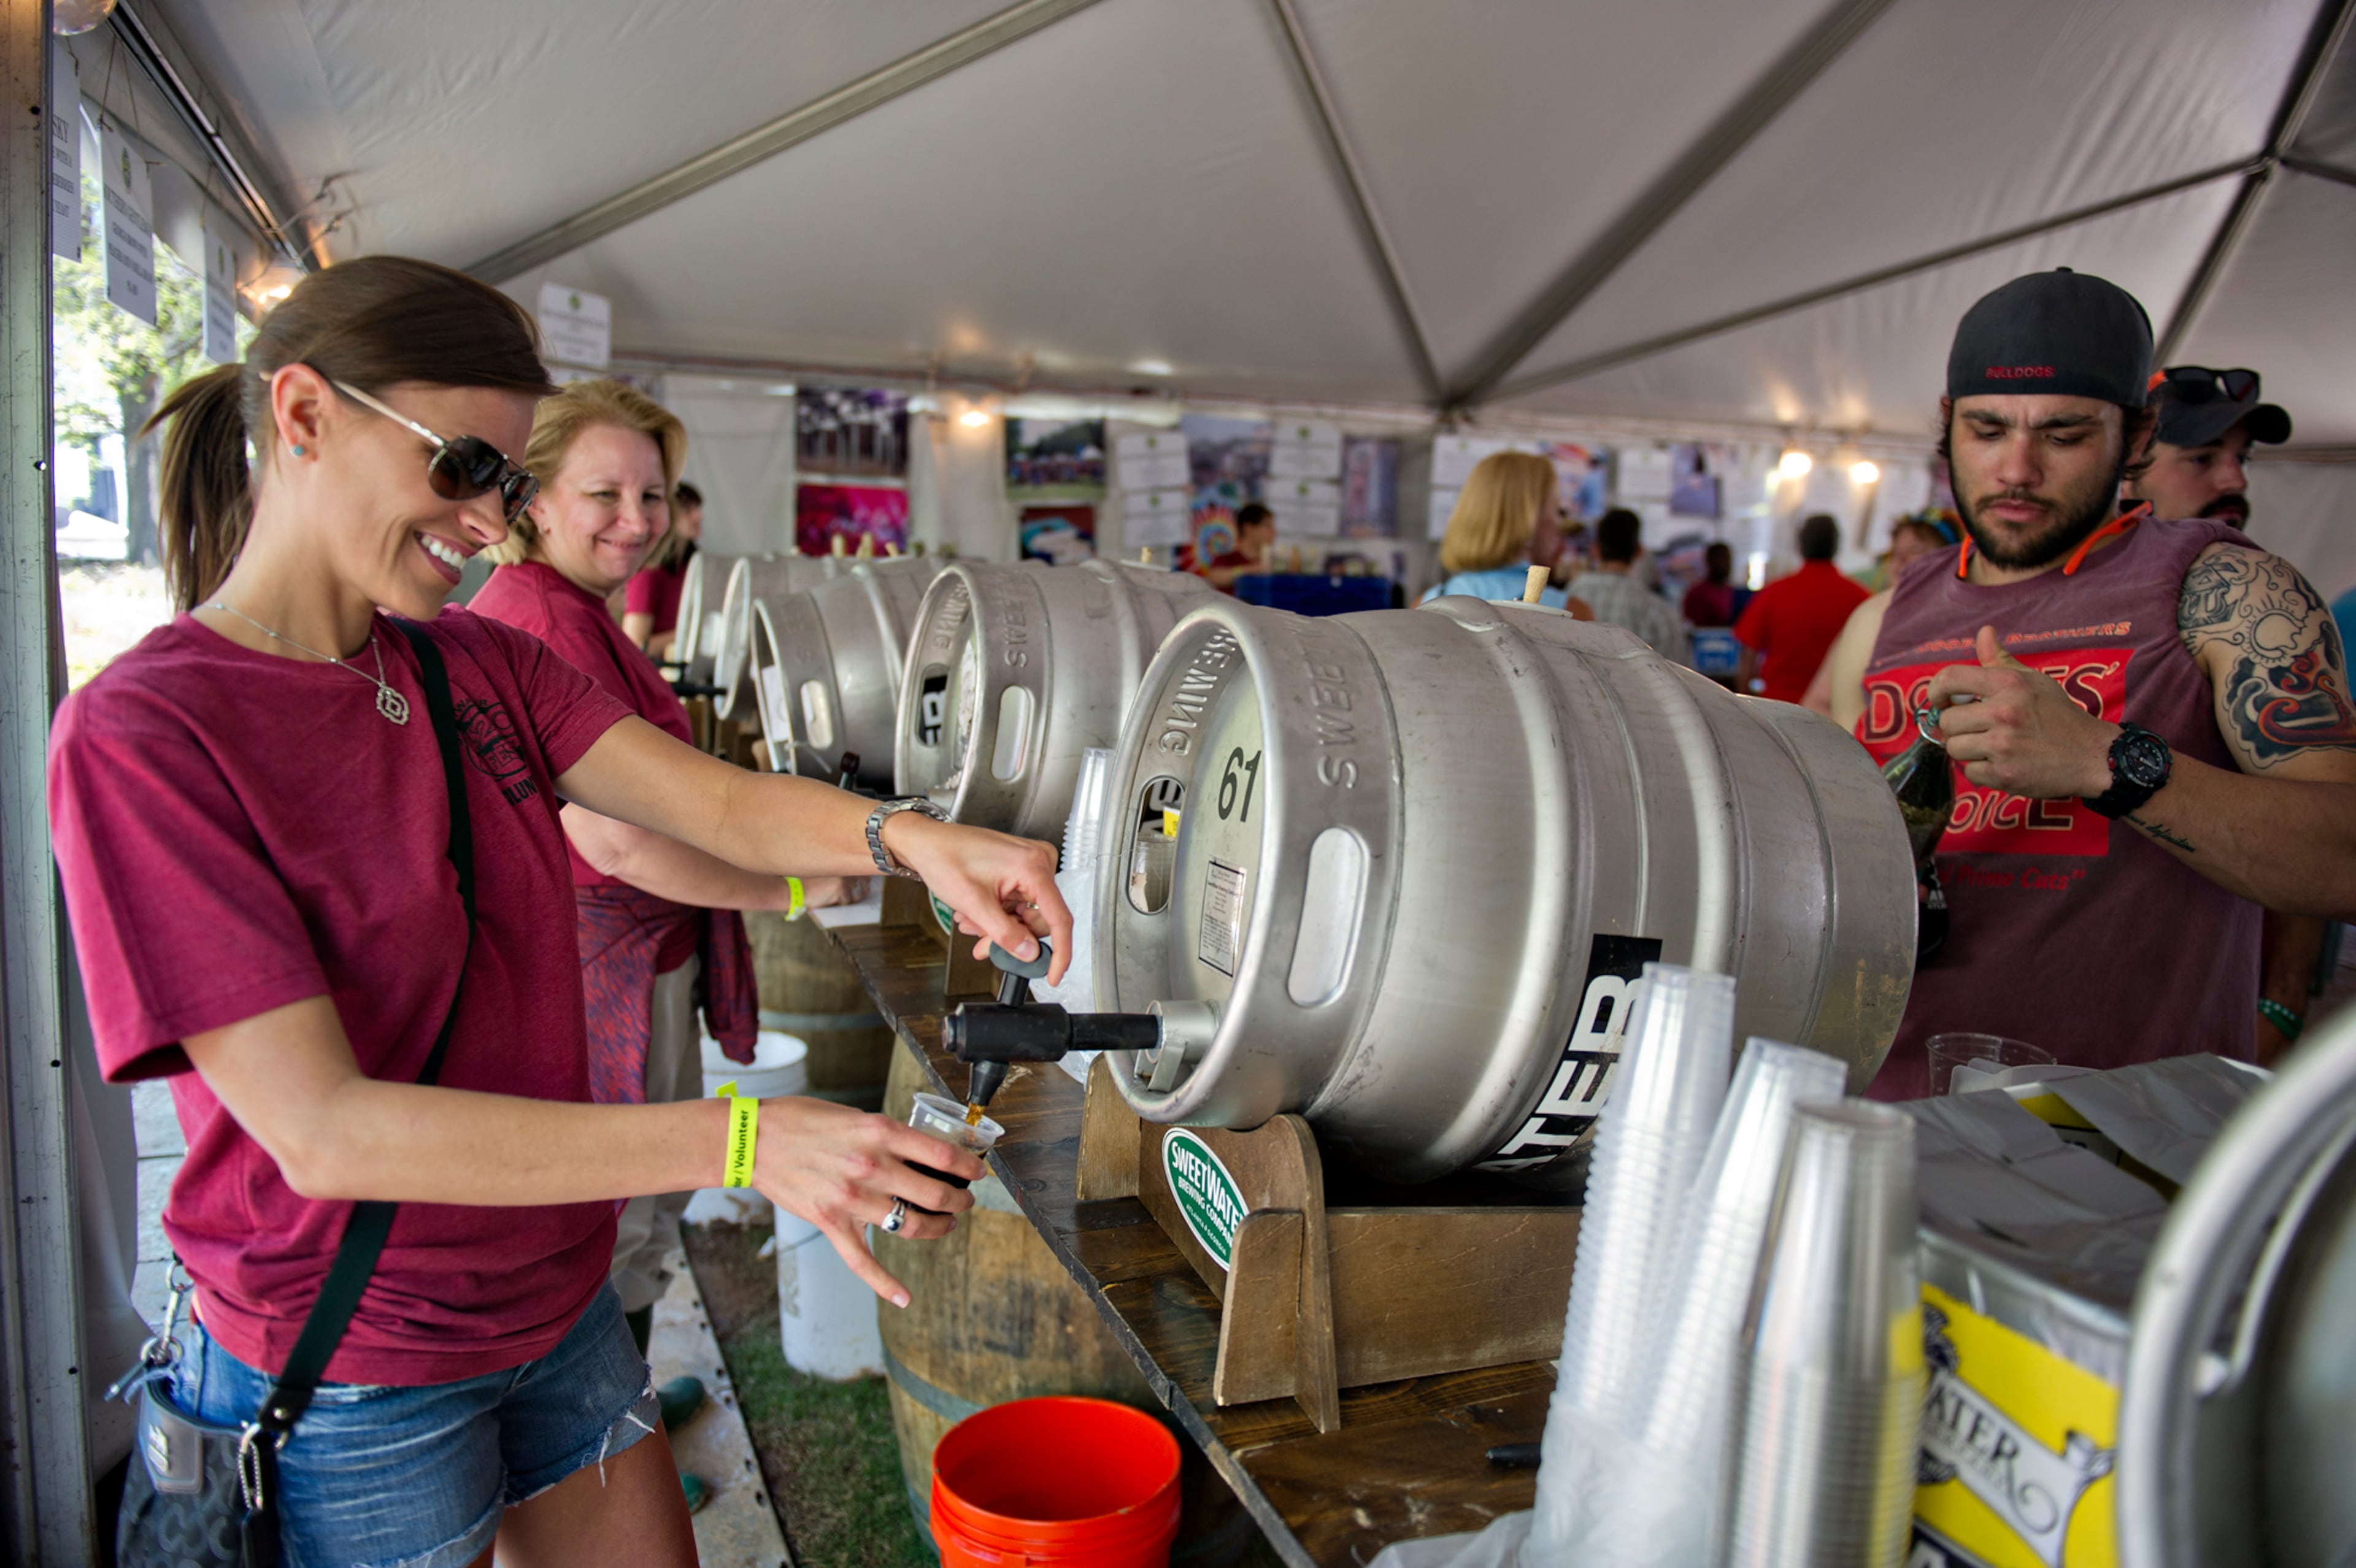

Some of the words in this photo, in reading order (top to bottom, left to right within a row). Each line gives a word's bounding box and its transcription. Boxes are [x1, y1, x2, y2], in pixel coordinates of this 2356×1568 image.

[1985, 365, 2055, 379] BULLDOGS
[1218, 747, 1261, 823] 61
[734, 1109, 749, 1169] Volunteer
[1171, 1141, 1244, 1233] SWEETWATE
[1177, 1176, 1206, 1210] BREWING
[1206, 1204, 1233, 1249] COMPAN
